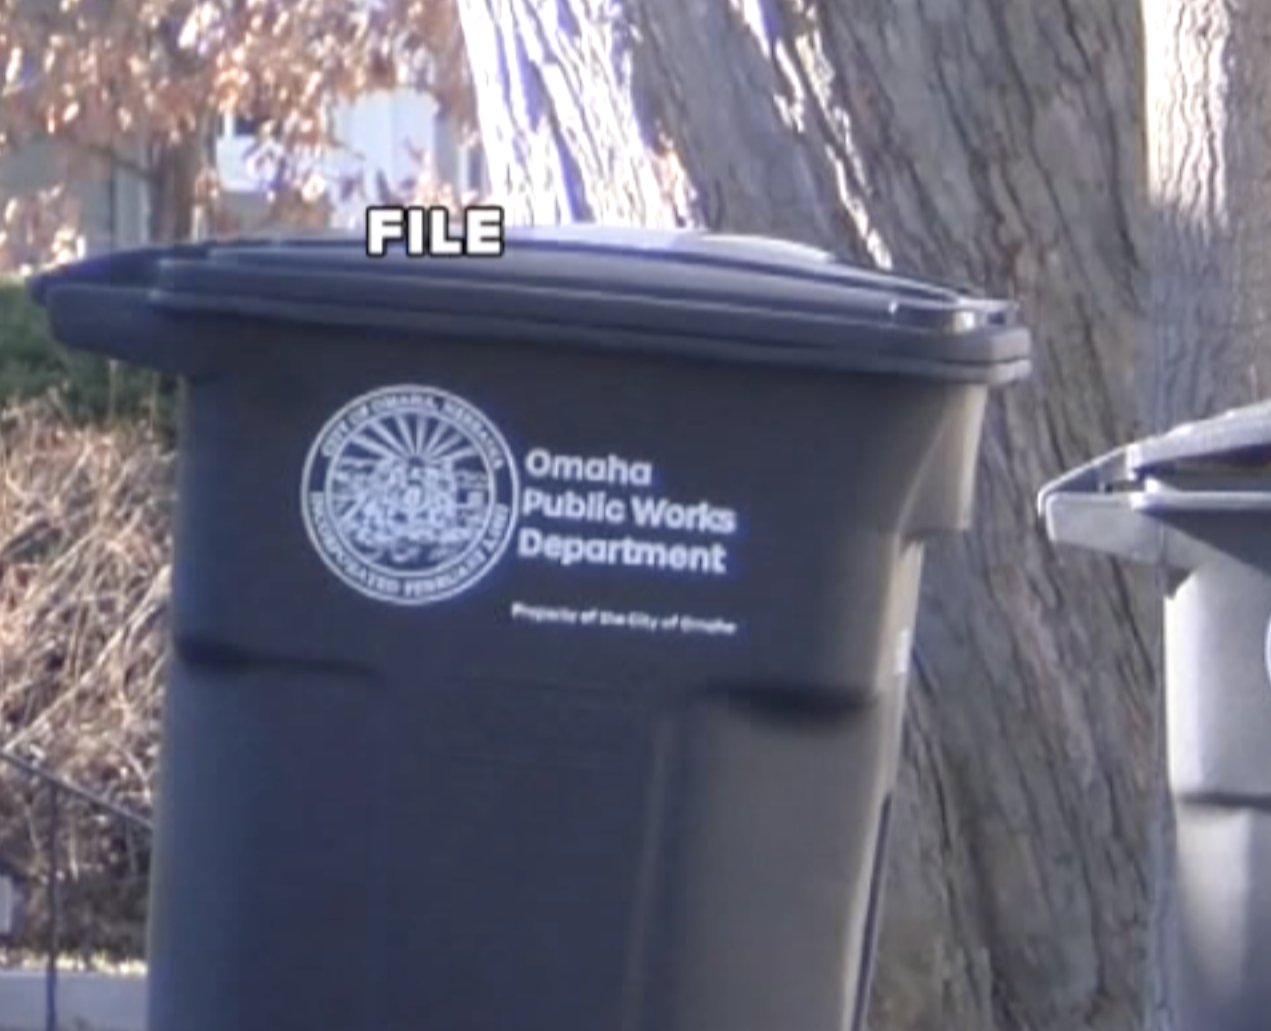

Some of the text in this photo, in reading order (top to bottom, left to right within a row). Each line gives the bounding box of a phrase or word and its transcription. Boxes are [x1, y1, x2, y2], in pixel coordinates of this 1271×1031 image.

[525, 448, 652, 486] Omaha
[523, 487, 736, 534] Public Works
[518, 527, 727, 575] Department
